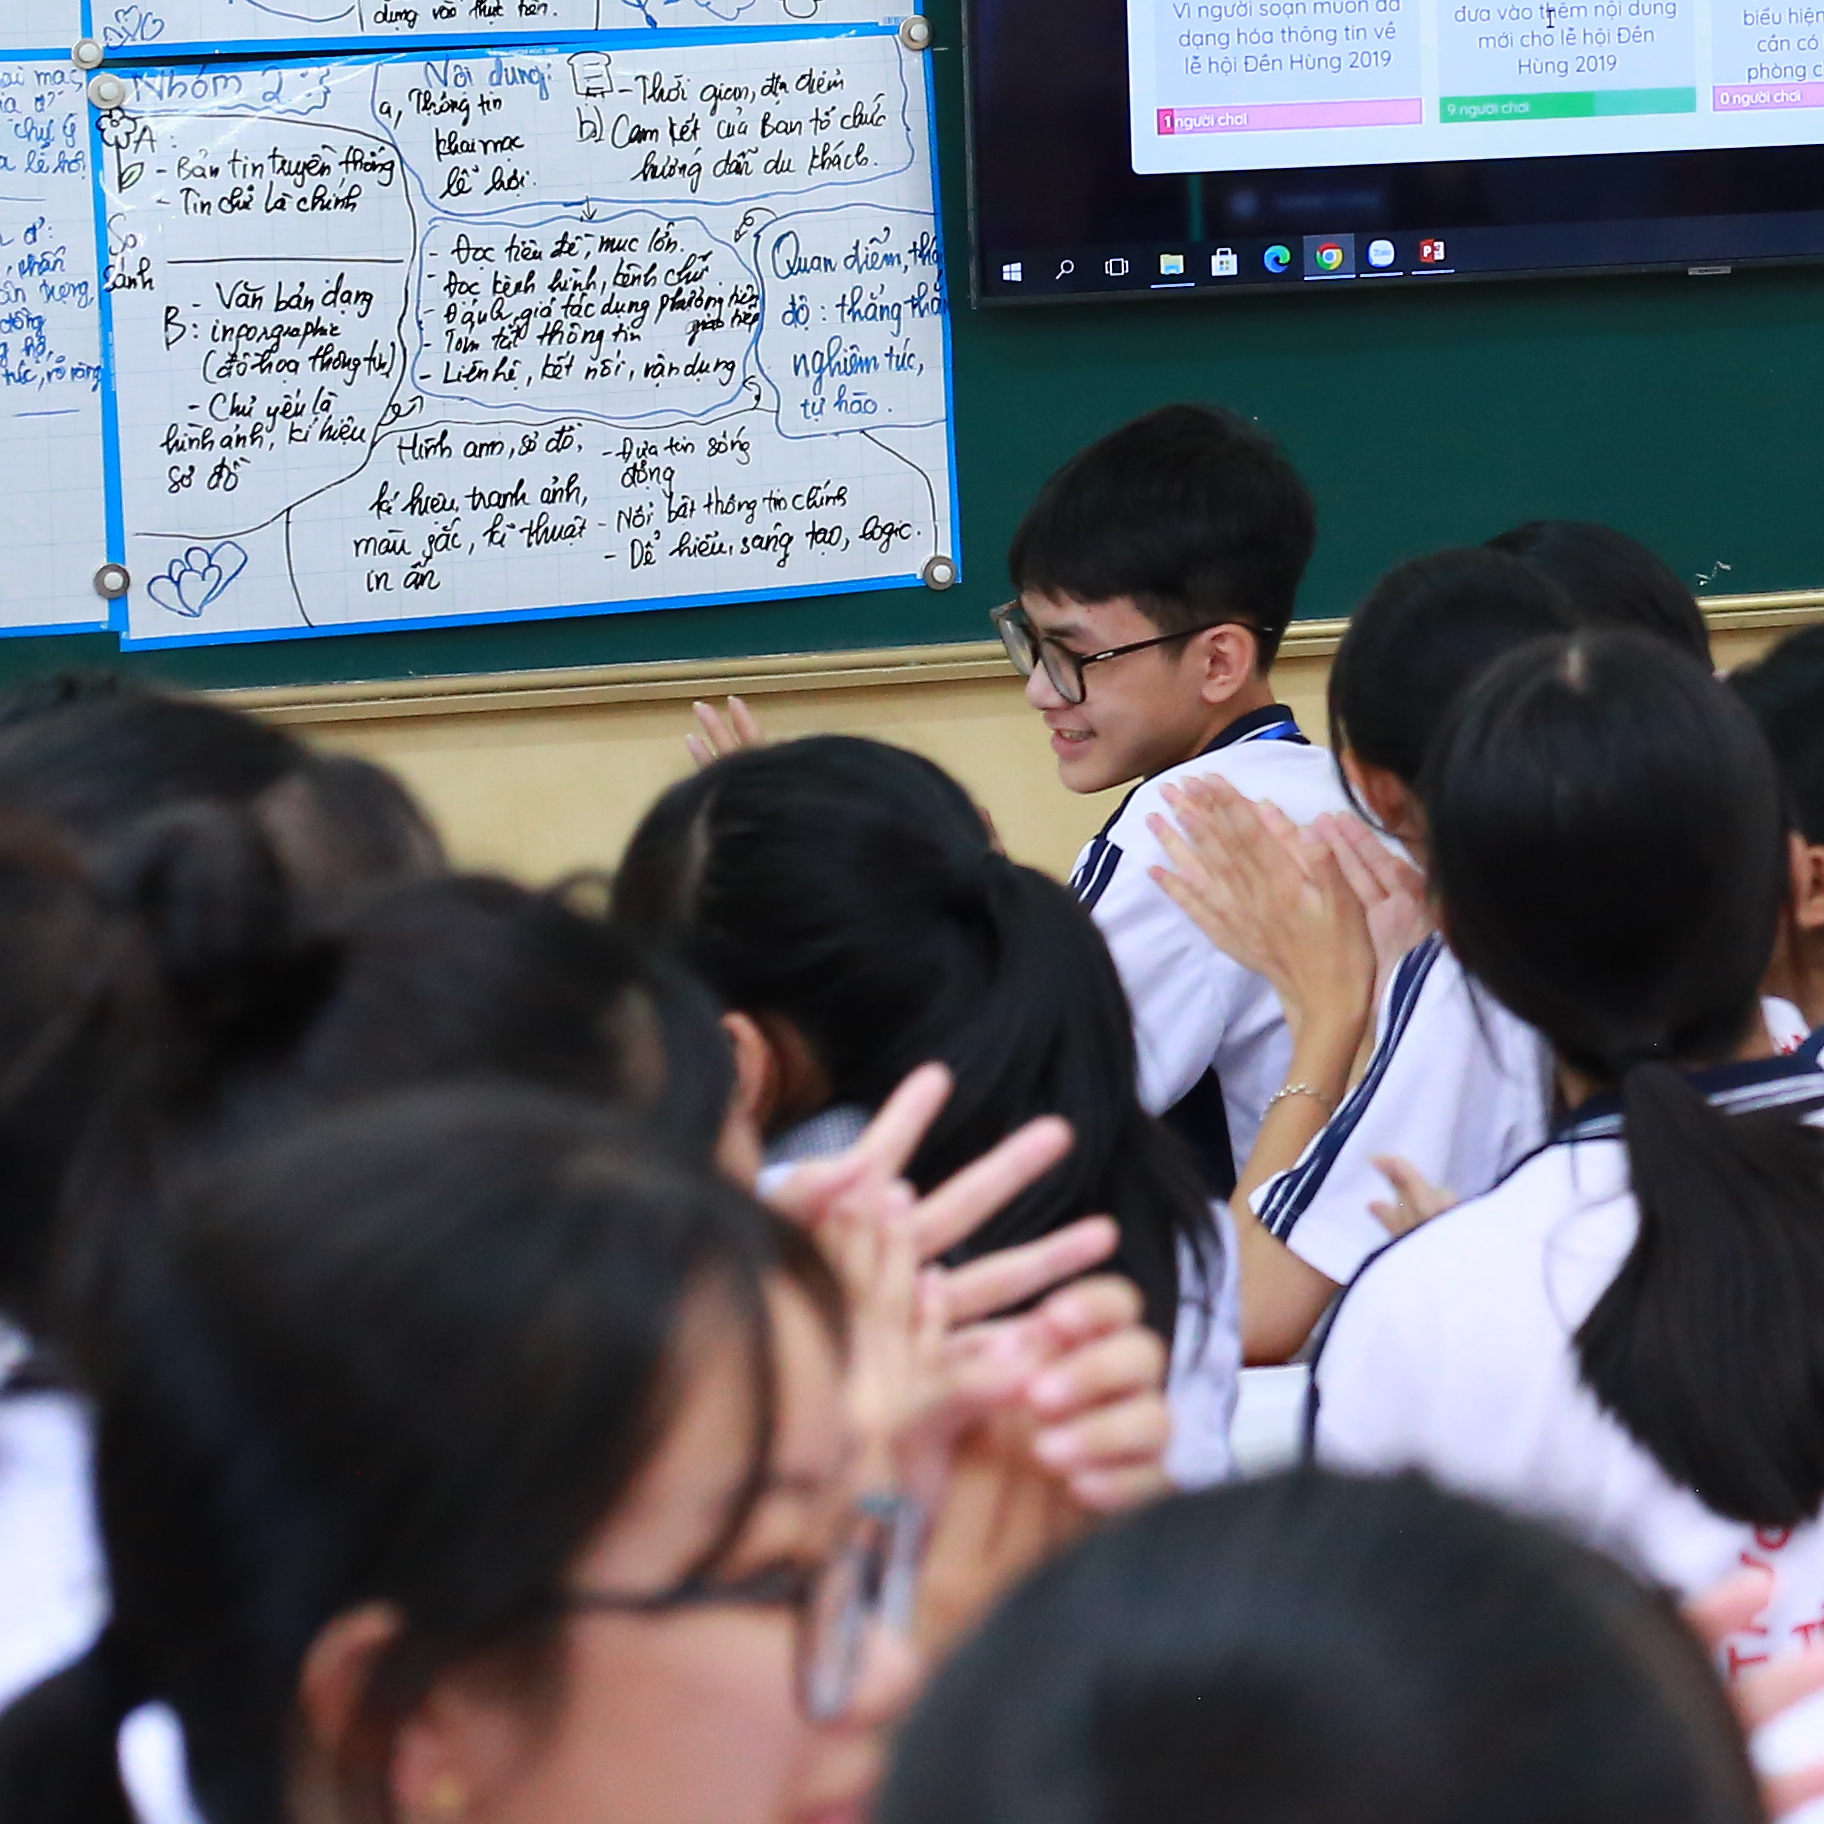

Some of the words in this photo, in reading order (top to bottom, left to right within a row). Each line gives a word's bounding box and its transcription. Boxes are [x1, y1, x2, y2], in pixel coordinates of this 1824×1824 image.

[1173, 1, 1191, 19] Vì
[1198, 1, 1253, 22] người
[1259, 0, 1307, 18] soạn
[1454, 5, 1491, 23] đưa
[1497, 3, 1533, 20] vào
[1595, 1, 1622, 20] nội
[1628, 0, 1677, 18] dung
[1743, 7, 1782, 26] biểu
[1178, 30, 1229, 49] dạng
[1237, 28, 1273, 45] hóa
[1281, 26, 1337, 46] thông
[1344, 25, 1367, 40] tin
[1478, 30, 1514, 49] mới
[1520, 31, 1554, 47] cho
[1561, 28, 1576, 46] lễ
[1583, 27, 1611, 47] hội
[1185, 55, 1201, 74] lễ
[1208, 57, 1237, 76] hội
[1290, 54, 1342, 73] Hùng
[1349, 50, 1392, 69] 2019
[1518, 58, 1568, 77] Hùng
[1576, 54, 1617, 73] 2019
[132, 64, 242, 102] Nhóm
[760, 113, 802, 138] Ban
[229, 148, 265, 178] tin
[772, 230, 836, 279] Quan
[216, 280, 265, 310] Văn
